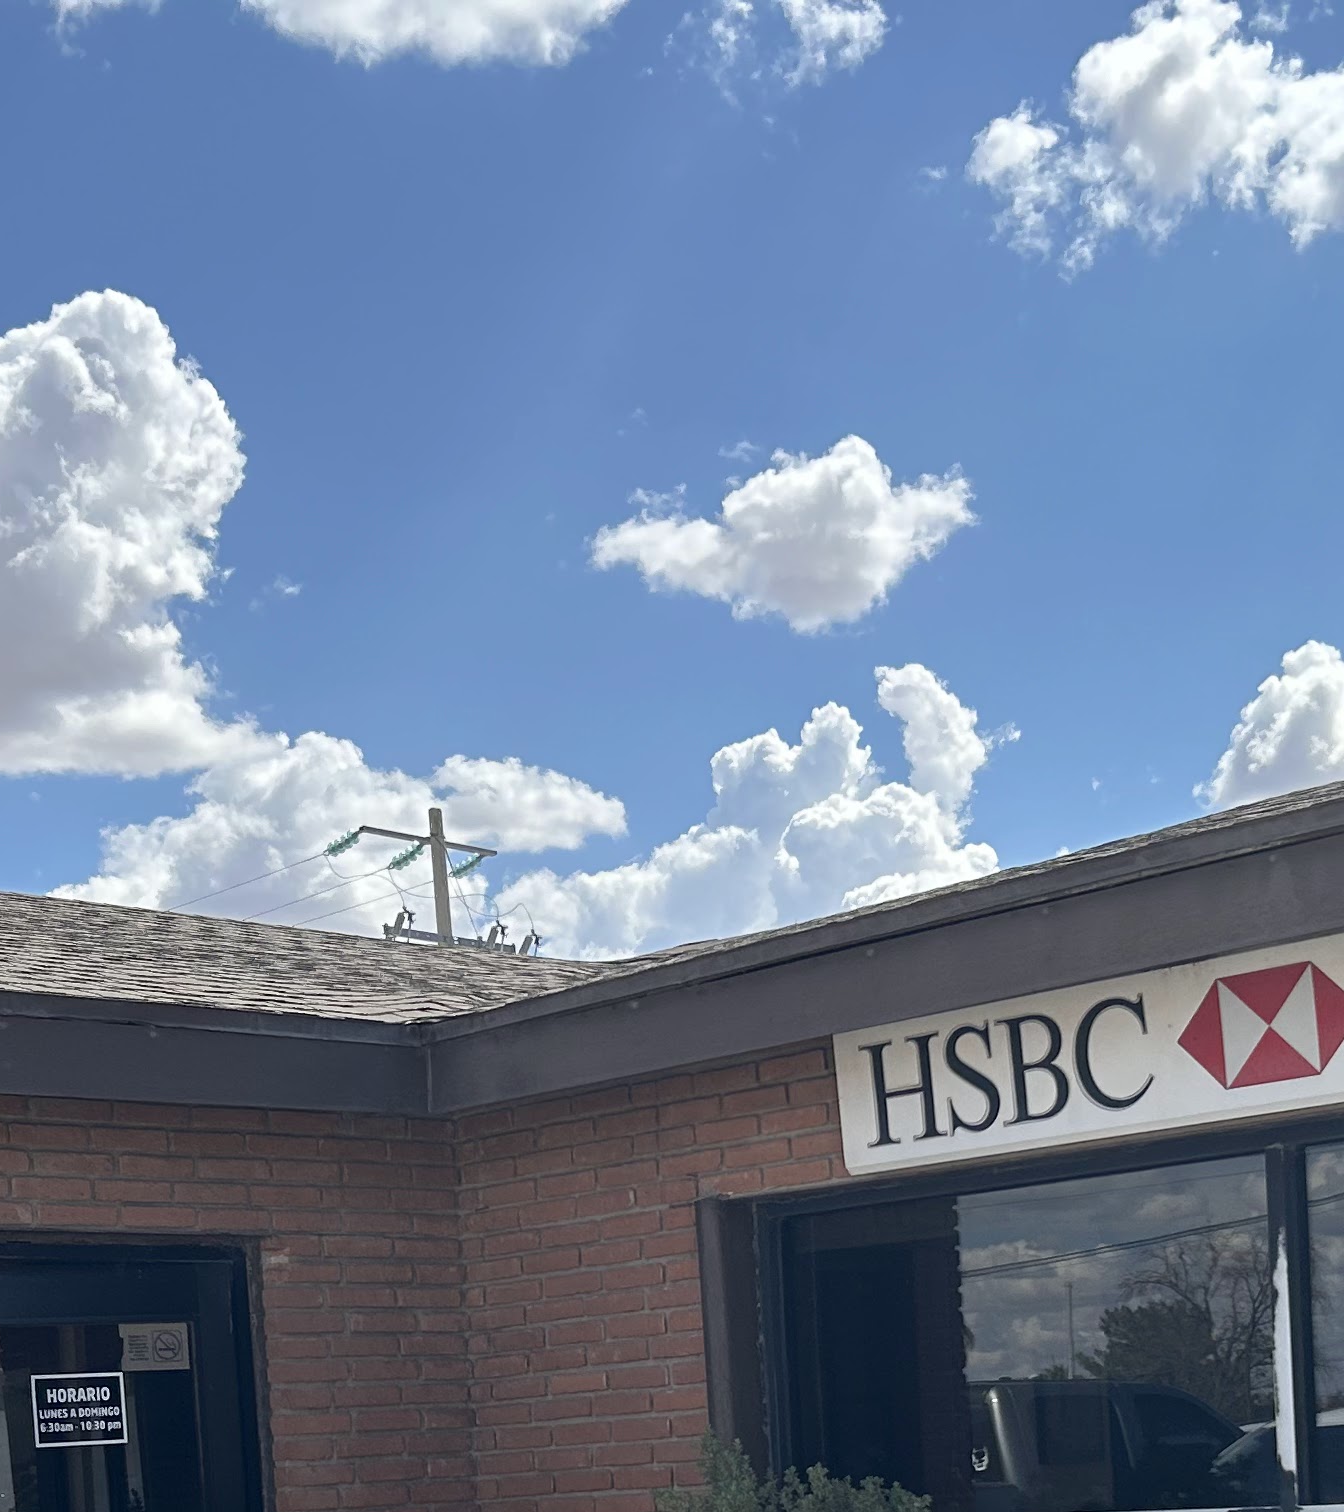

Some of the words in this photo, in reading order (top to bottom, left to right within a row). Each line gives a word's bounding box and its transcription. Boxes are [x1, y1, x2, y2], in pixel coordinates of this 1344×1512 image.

[857, 992, 1155, 1148] HSBC
[46, 1386, 111, 1403] HORARIO
[38, 1408, 69, 1420] LUNES
[69, 1408, 77, 1418] A
[78, 1406, 120, 1418] DOMINGO
[107, 1421, 122, 1432] pm
